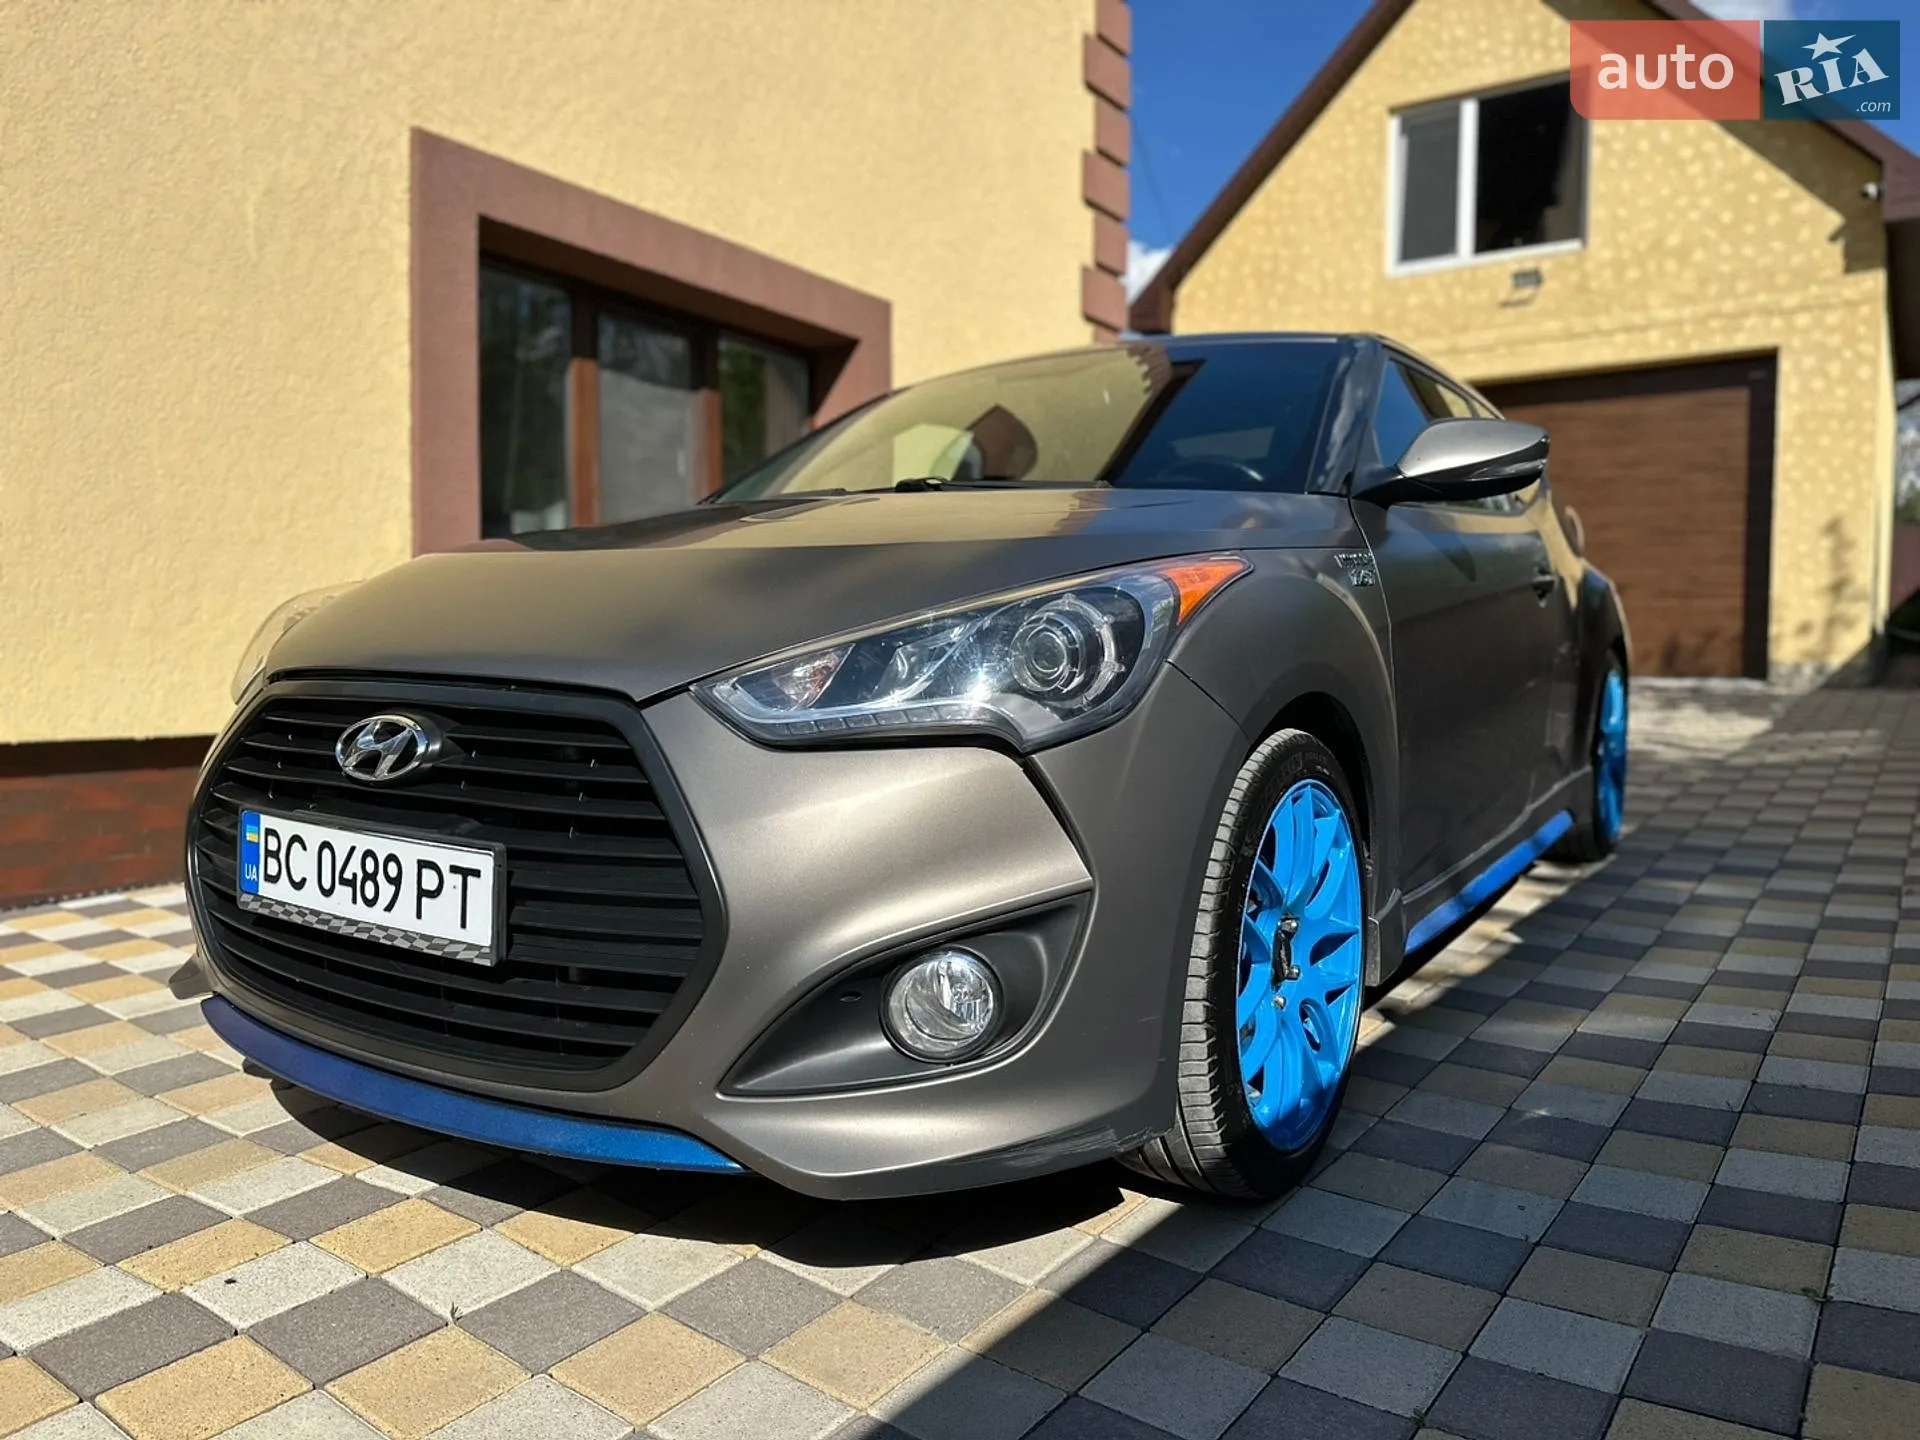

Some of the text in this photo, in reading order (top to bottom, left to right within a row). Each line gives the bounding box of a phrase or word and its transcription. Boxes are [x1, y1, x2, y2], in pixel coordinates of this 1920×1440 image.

[244, 864, 258, 881] UA
[263, 827, 482, 929] BC 0489 PT
